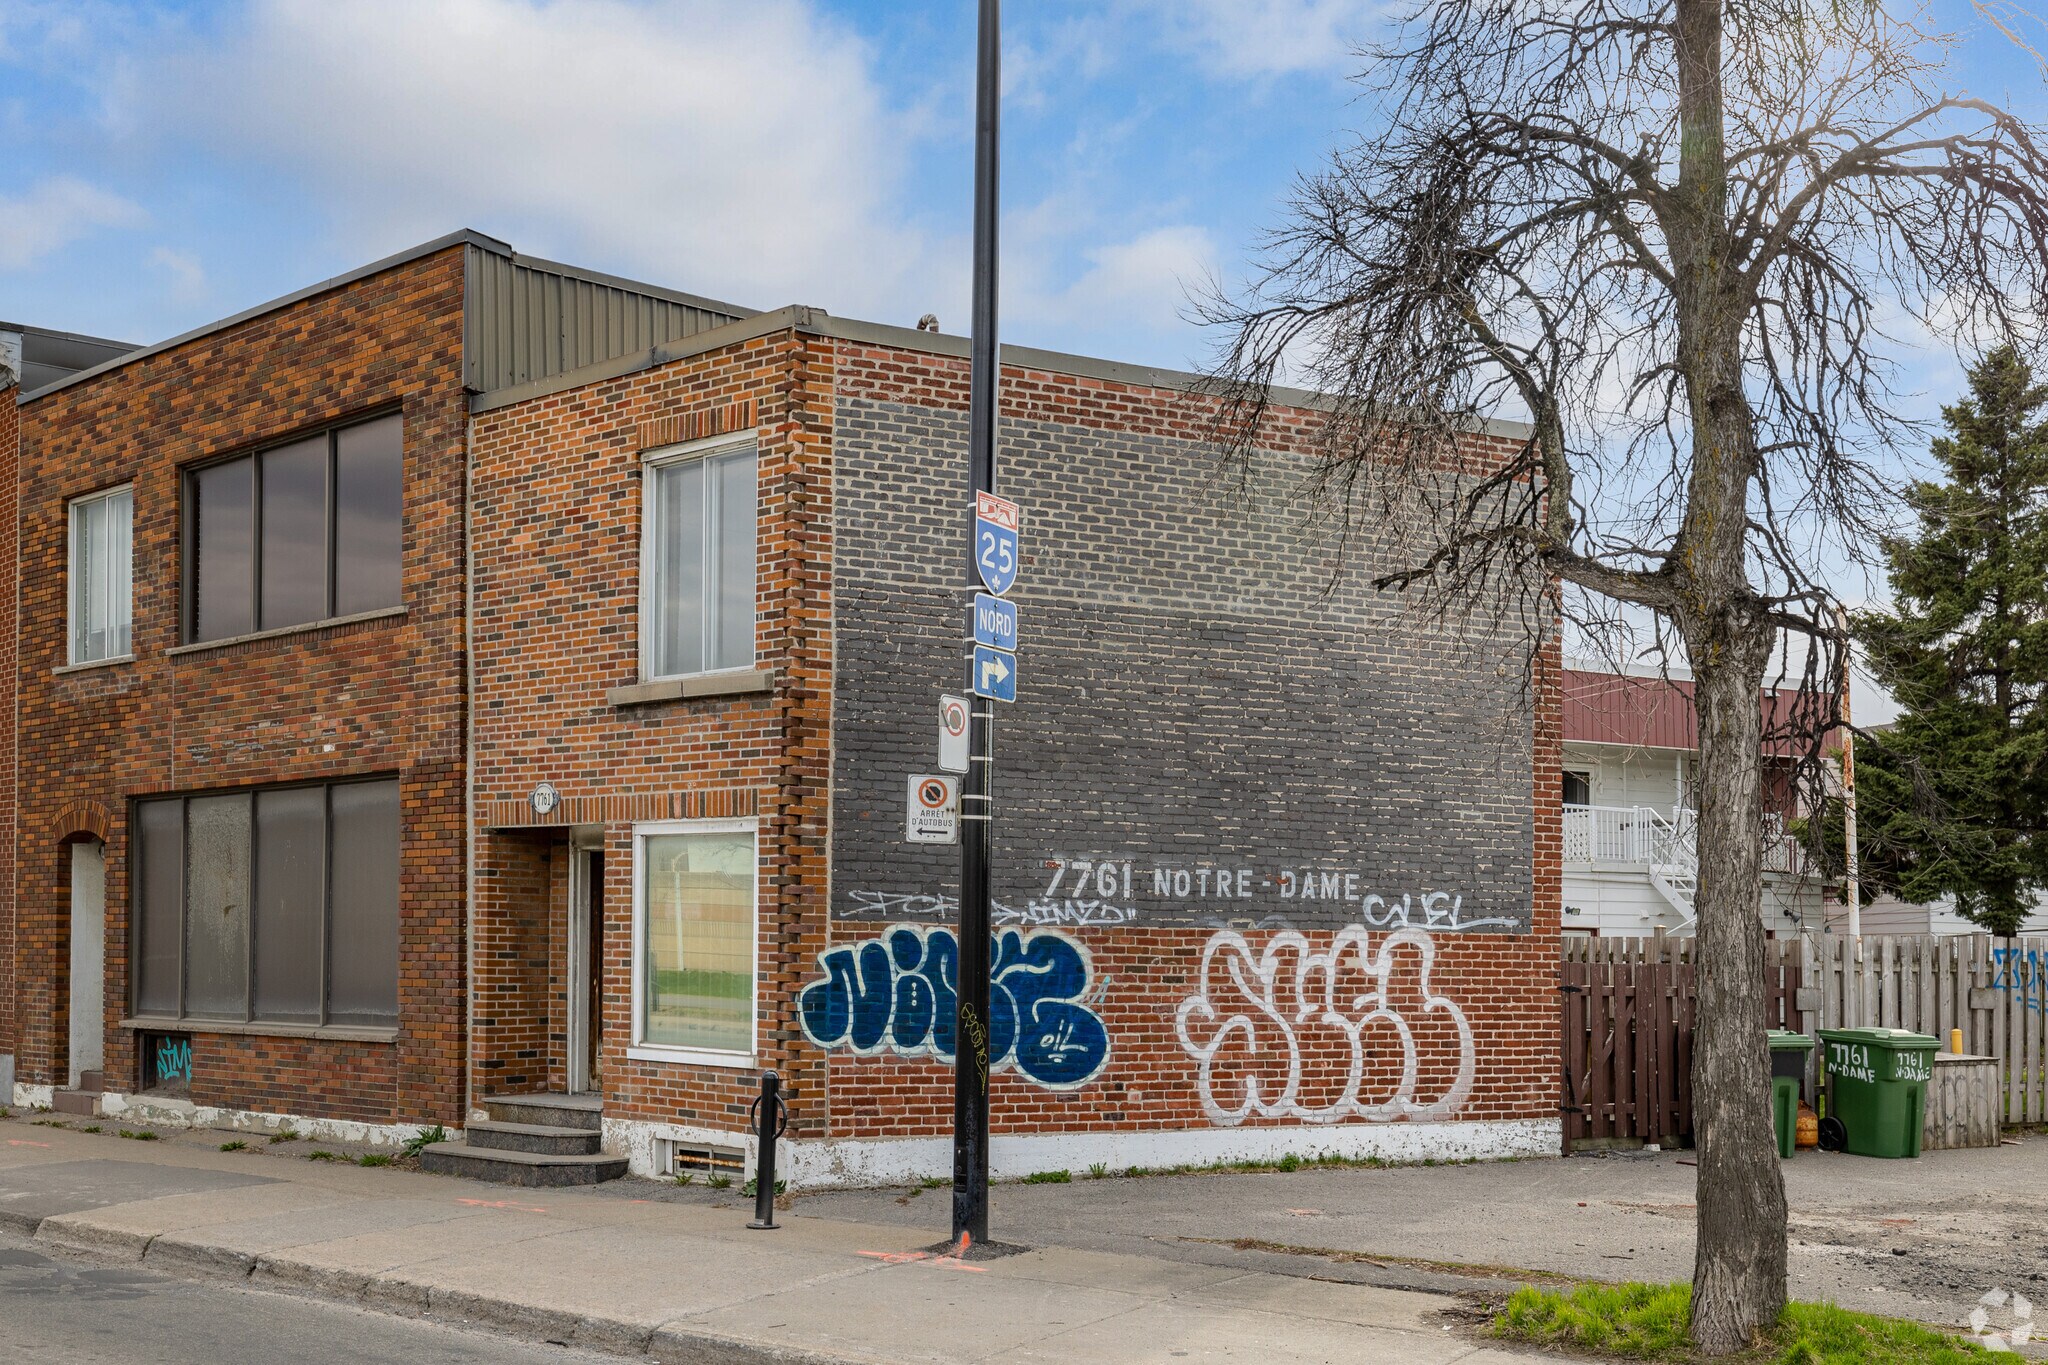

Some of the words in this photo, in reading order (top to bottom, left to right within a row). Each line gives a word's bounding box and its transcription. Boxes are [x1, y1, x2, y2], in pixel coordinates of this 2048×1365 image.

[981, 531, 1012, 574] 25
[979, 607, 1012, 637] NORD
[537, 792, 551, 806] 7761
[911, 817, 953, 827] D'AUTOBUS
[920, 808, 945, 818] ARRÊT
[1045, 860, 1131, 898] 7761
[1831, 1043, 1869, 1068] 7761
[1897, 1051, 1923, 1069] 7761
[1828, 1062, 1875, 1083] N-DAME
